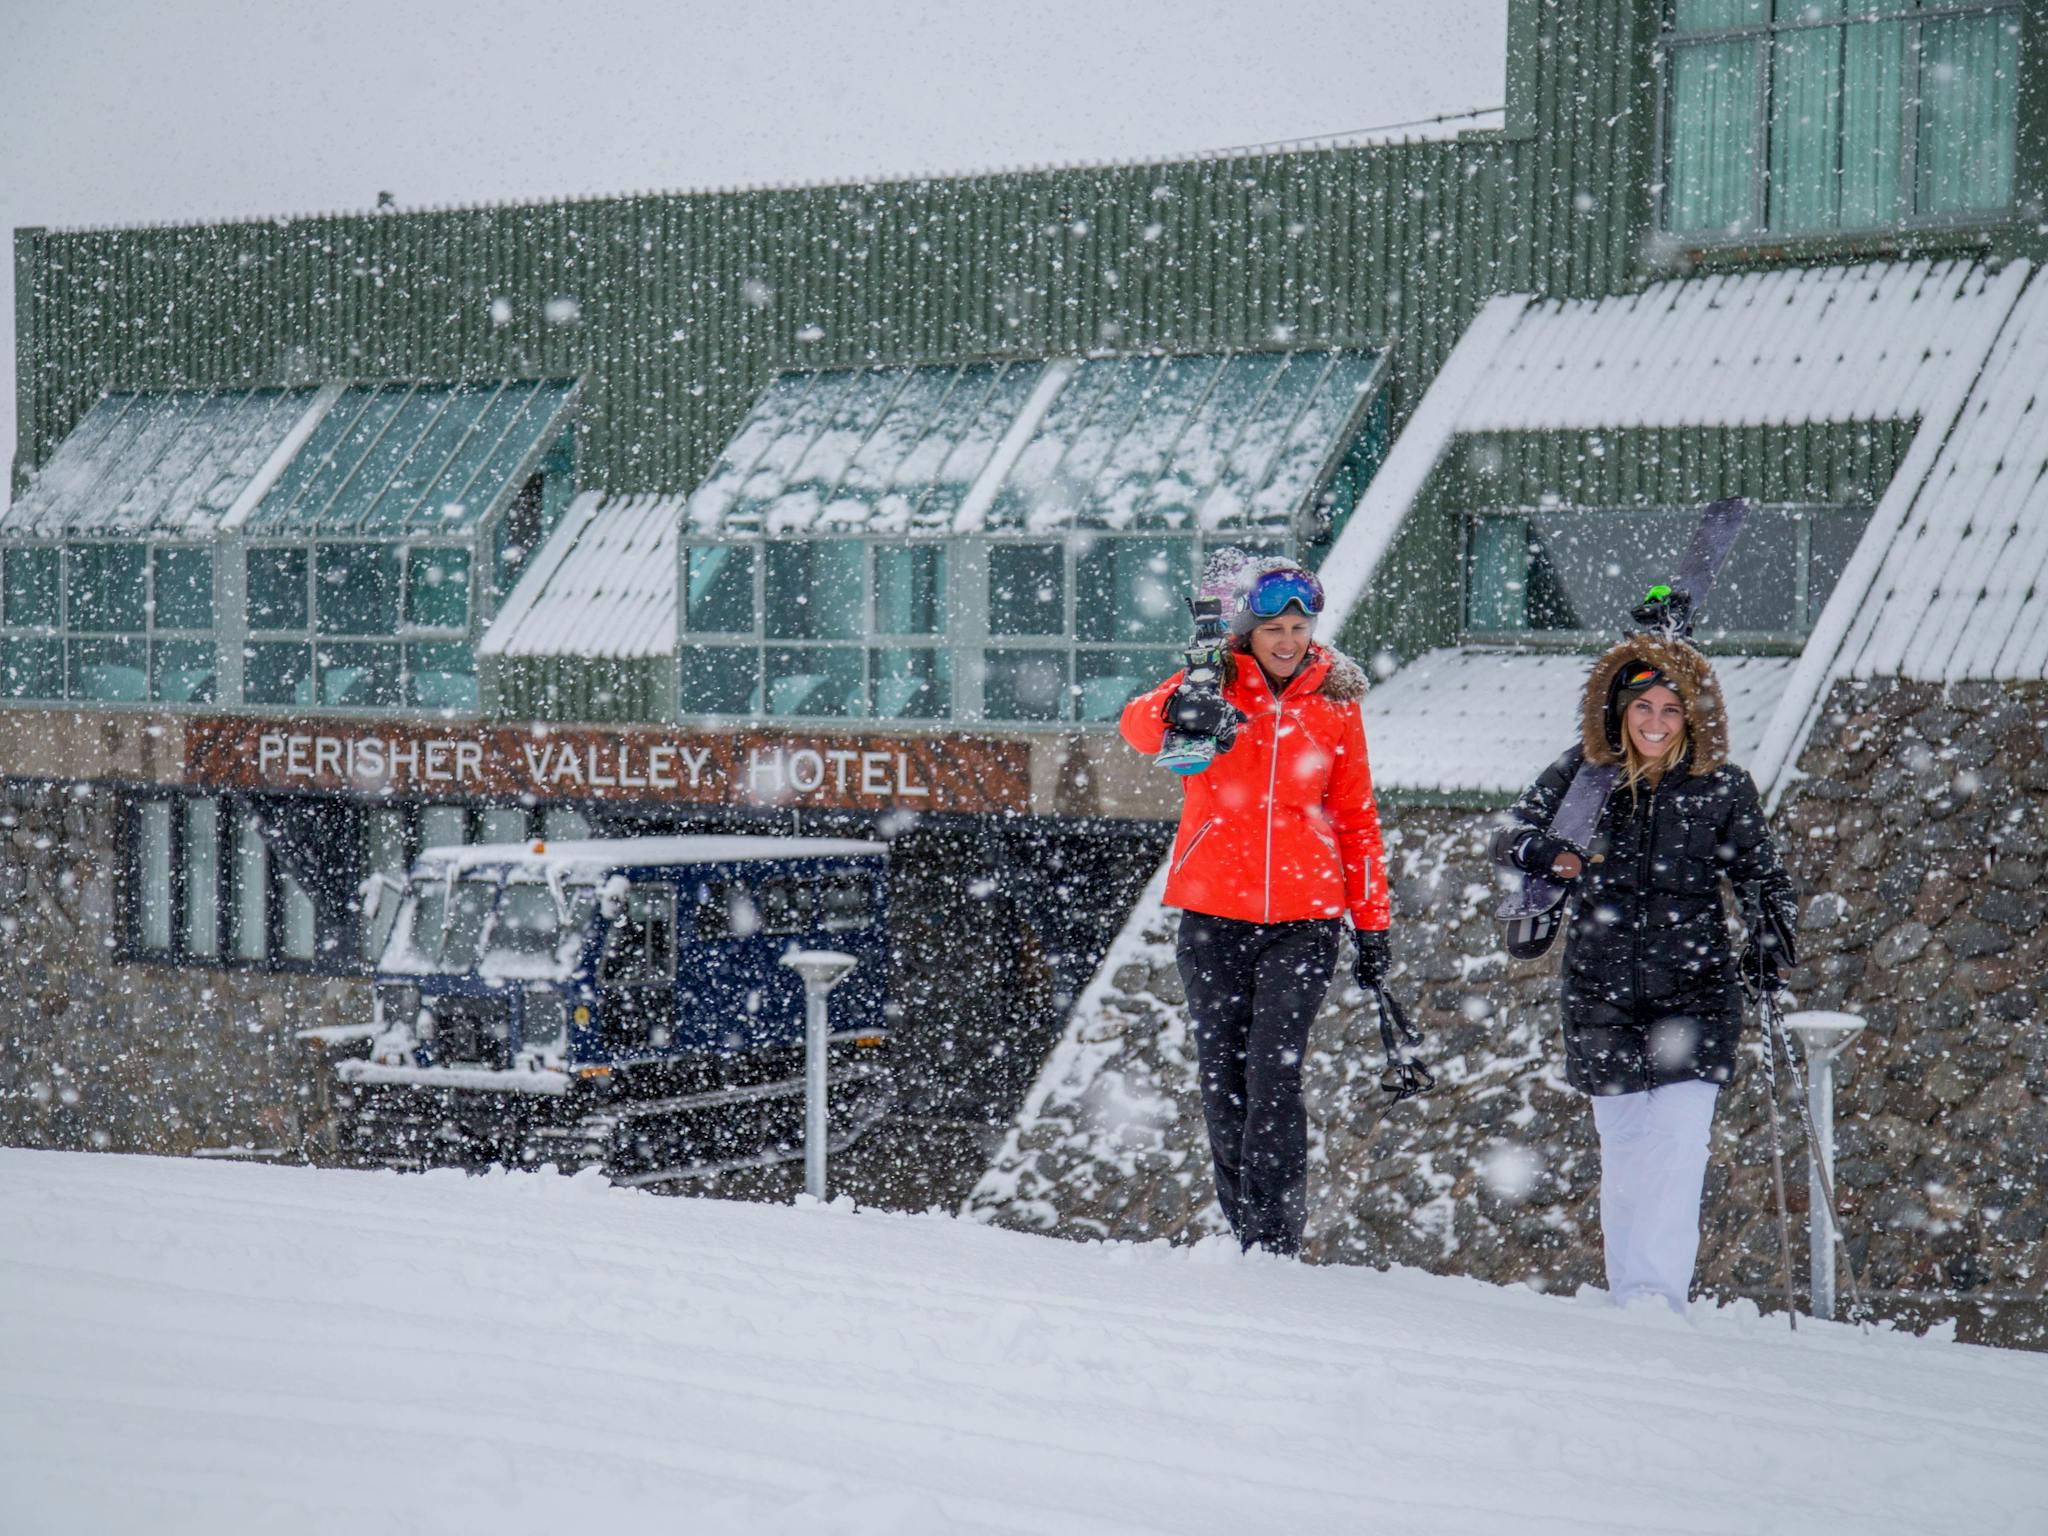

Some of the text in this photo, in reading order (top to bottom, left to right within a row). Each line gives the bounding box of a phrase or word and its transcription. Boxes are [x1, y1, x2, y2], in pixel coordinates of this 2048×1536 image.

[259, 735, 929, 796] PERISHER VALLEY HOTEL
